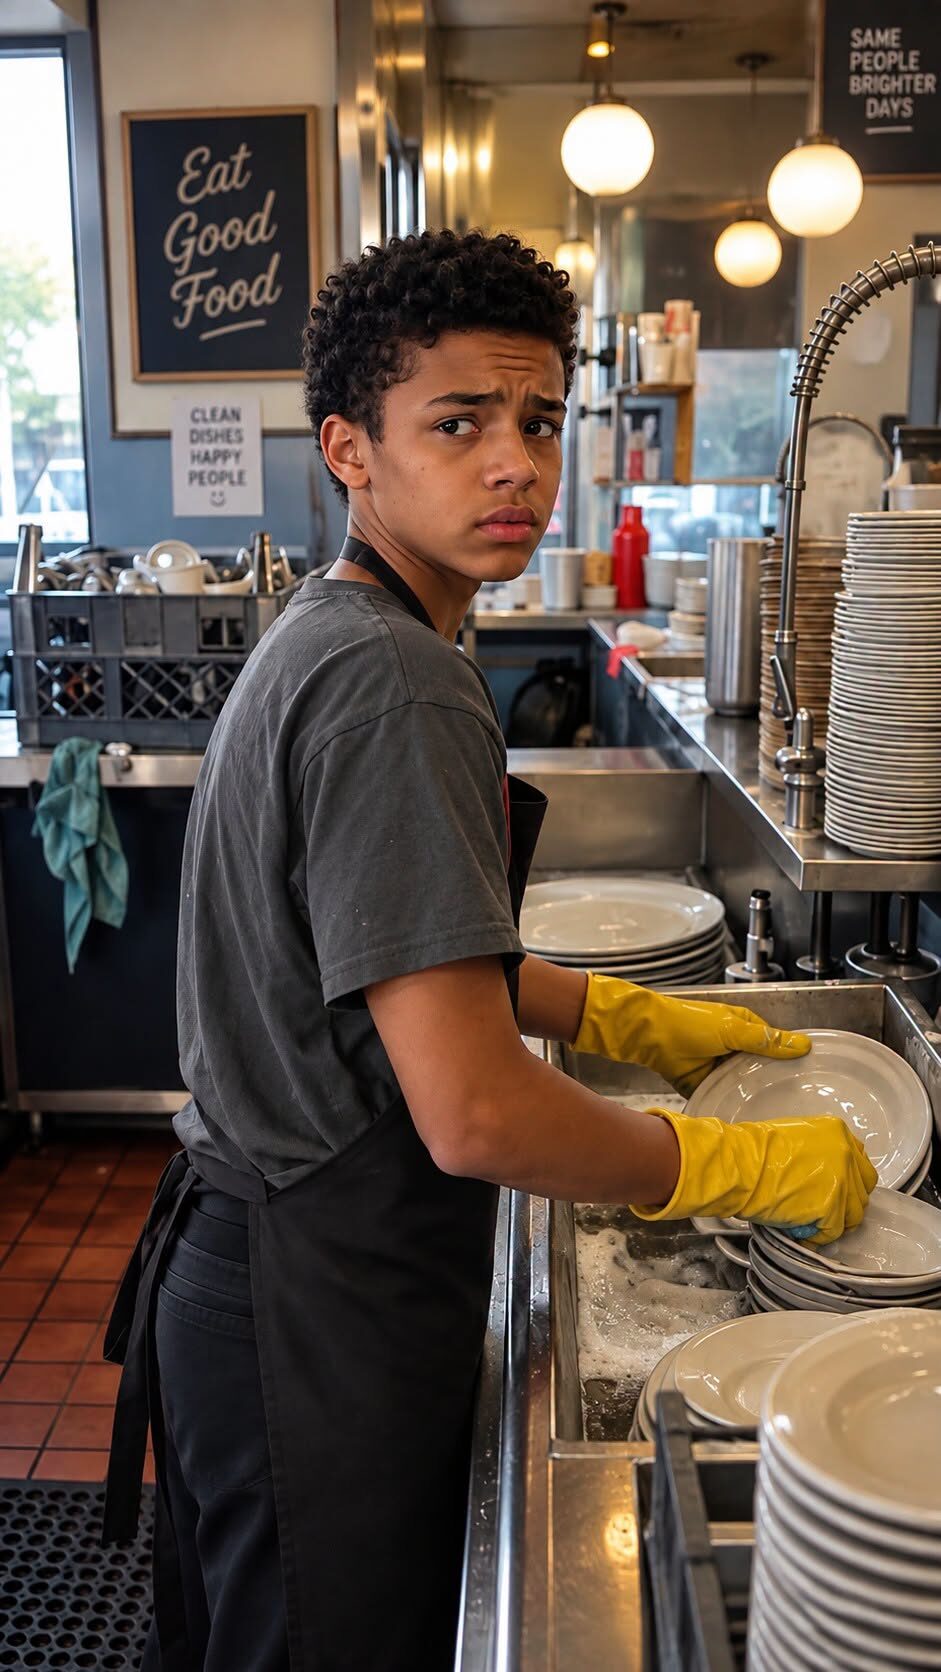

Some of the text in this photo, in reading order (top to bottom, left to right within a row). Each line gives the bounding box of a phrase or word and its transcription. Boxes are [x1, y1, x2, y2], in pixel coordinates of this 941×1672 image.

[851, 28, 901, 49] SAME
[850, 51, 919, 71] PEOPLE
[849, 74, 937, 95] BRIGHTER
[866, 98, 913, 119] DAYS
[177, 143, 253, 204] Eat
[164, 190, 277, 276] Good
[170, 252, 282, 329] Food
[190, 407, 241, 424] CLEAN
[189, 428, 243, 444] DISHES
[190, 450, 242, 465] HAPPY
[188, 469, 246, 487] PEOPLE
